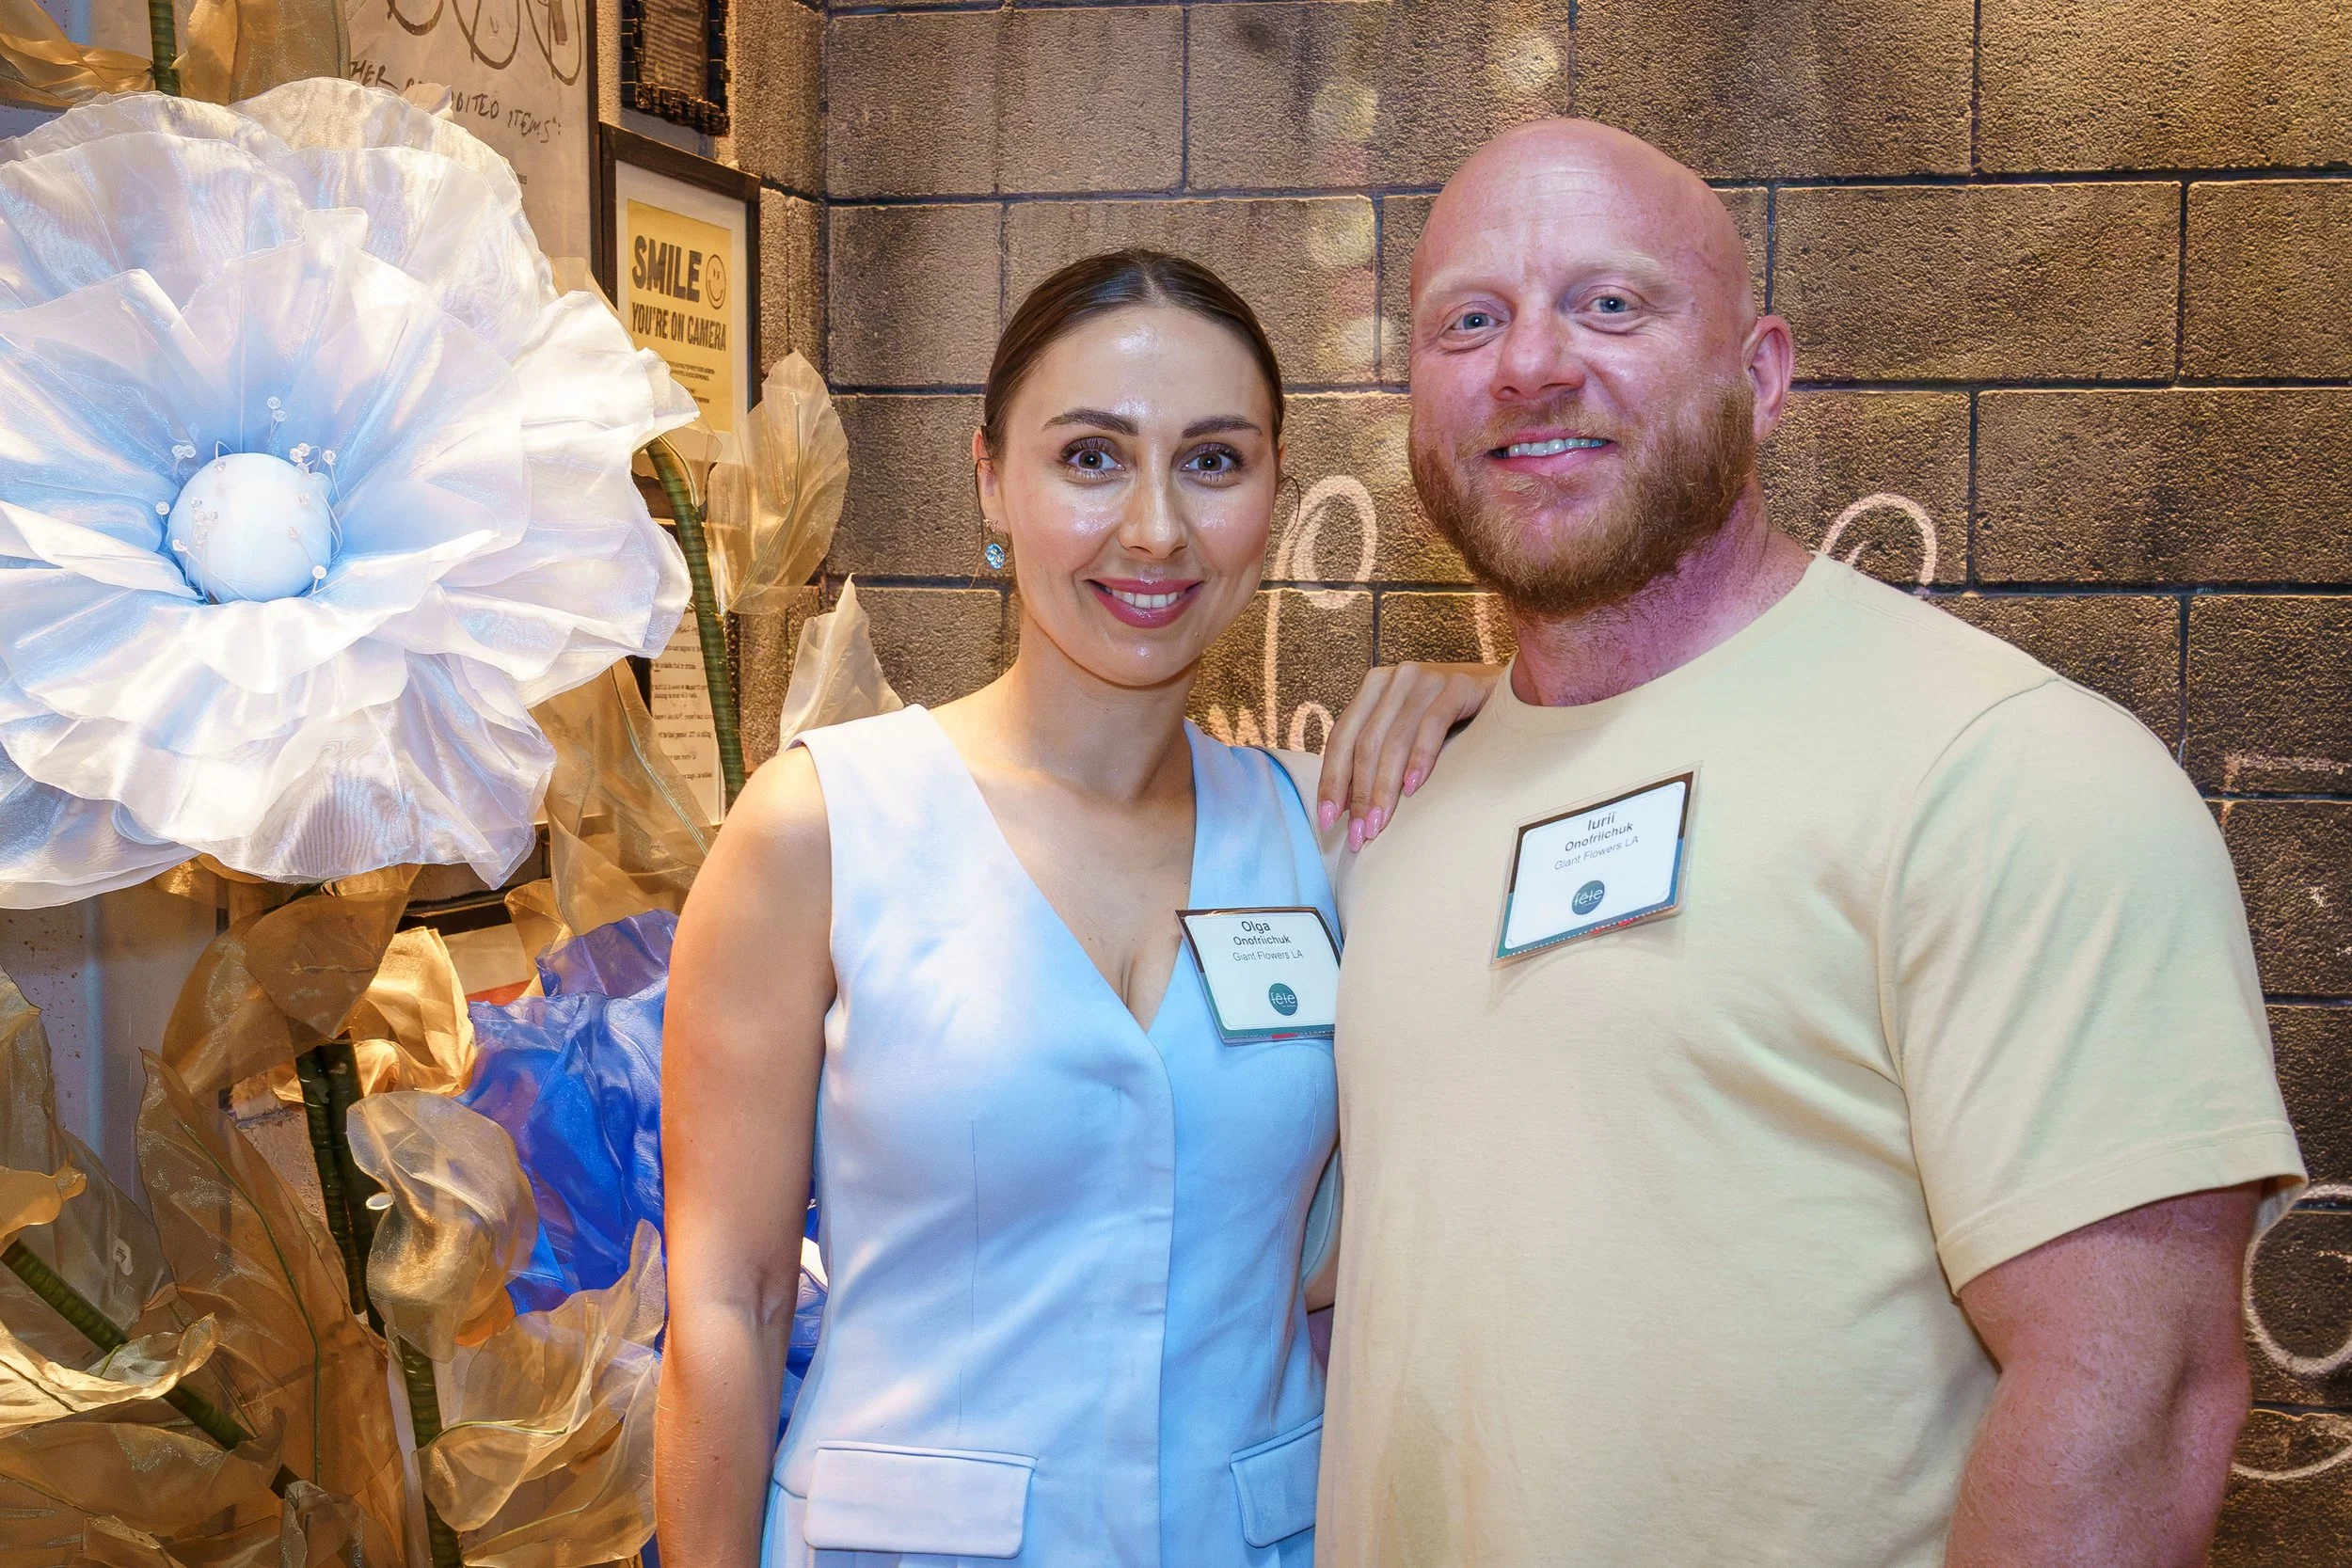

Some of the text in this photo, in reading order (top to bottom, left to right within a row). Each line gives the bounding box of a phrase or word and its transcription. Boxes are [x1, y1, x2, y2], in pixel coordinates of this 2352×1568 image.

[632, 235, 702, 303] SMILE
[632, 302, 726, 352] YOU'RE ON CAMERA
[1587, 812, 1615, 831] Iurii
[1565, 823, 1633, 851] Onofriichuk
[1554, 835, 1639, 870] Giant Flowers LA
[1241, 921, 1271, 934] Olga
[1233, 935, 1292, 945] Onofriichuk
[1232, 950, 1304, 961] Giant Flowers LA
